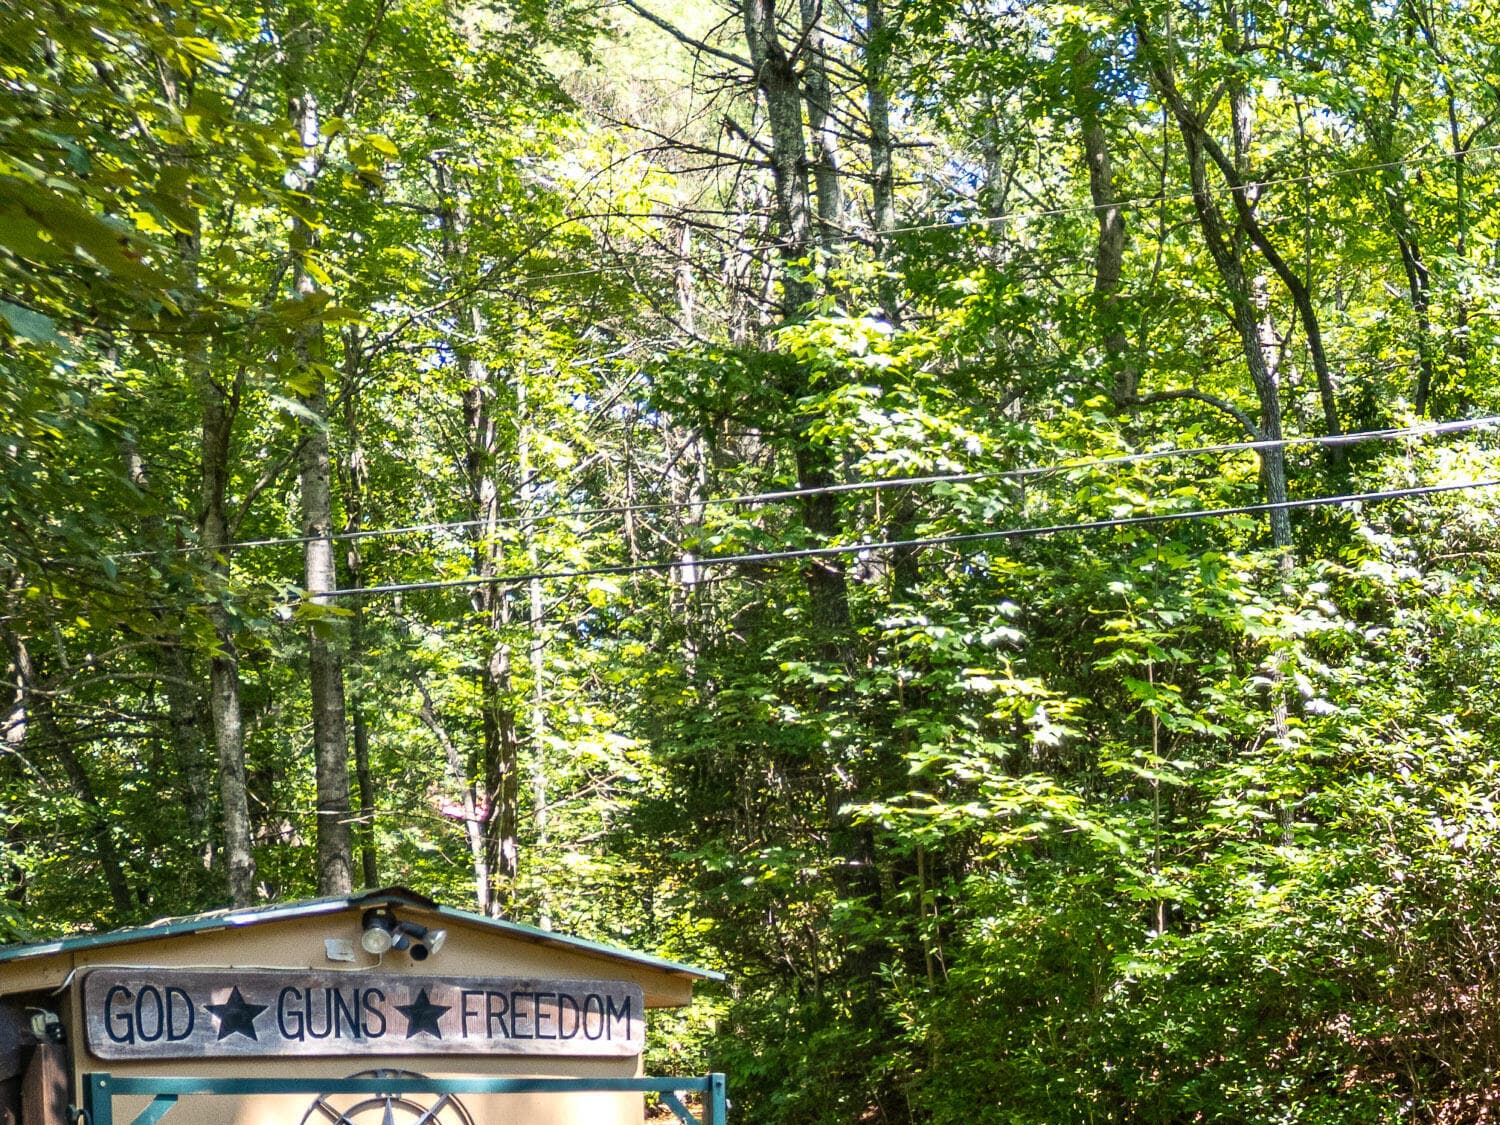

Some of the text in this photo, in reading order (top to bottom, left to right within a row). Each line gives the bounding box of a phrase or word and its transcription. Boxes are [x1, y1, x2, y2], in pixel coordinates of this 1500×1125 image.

[104, 984, 632, 1045] GOD GUNS FREEDOM
